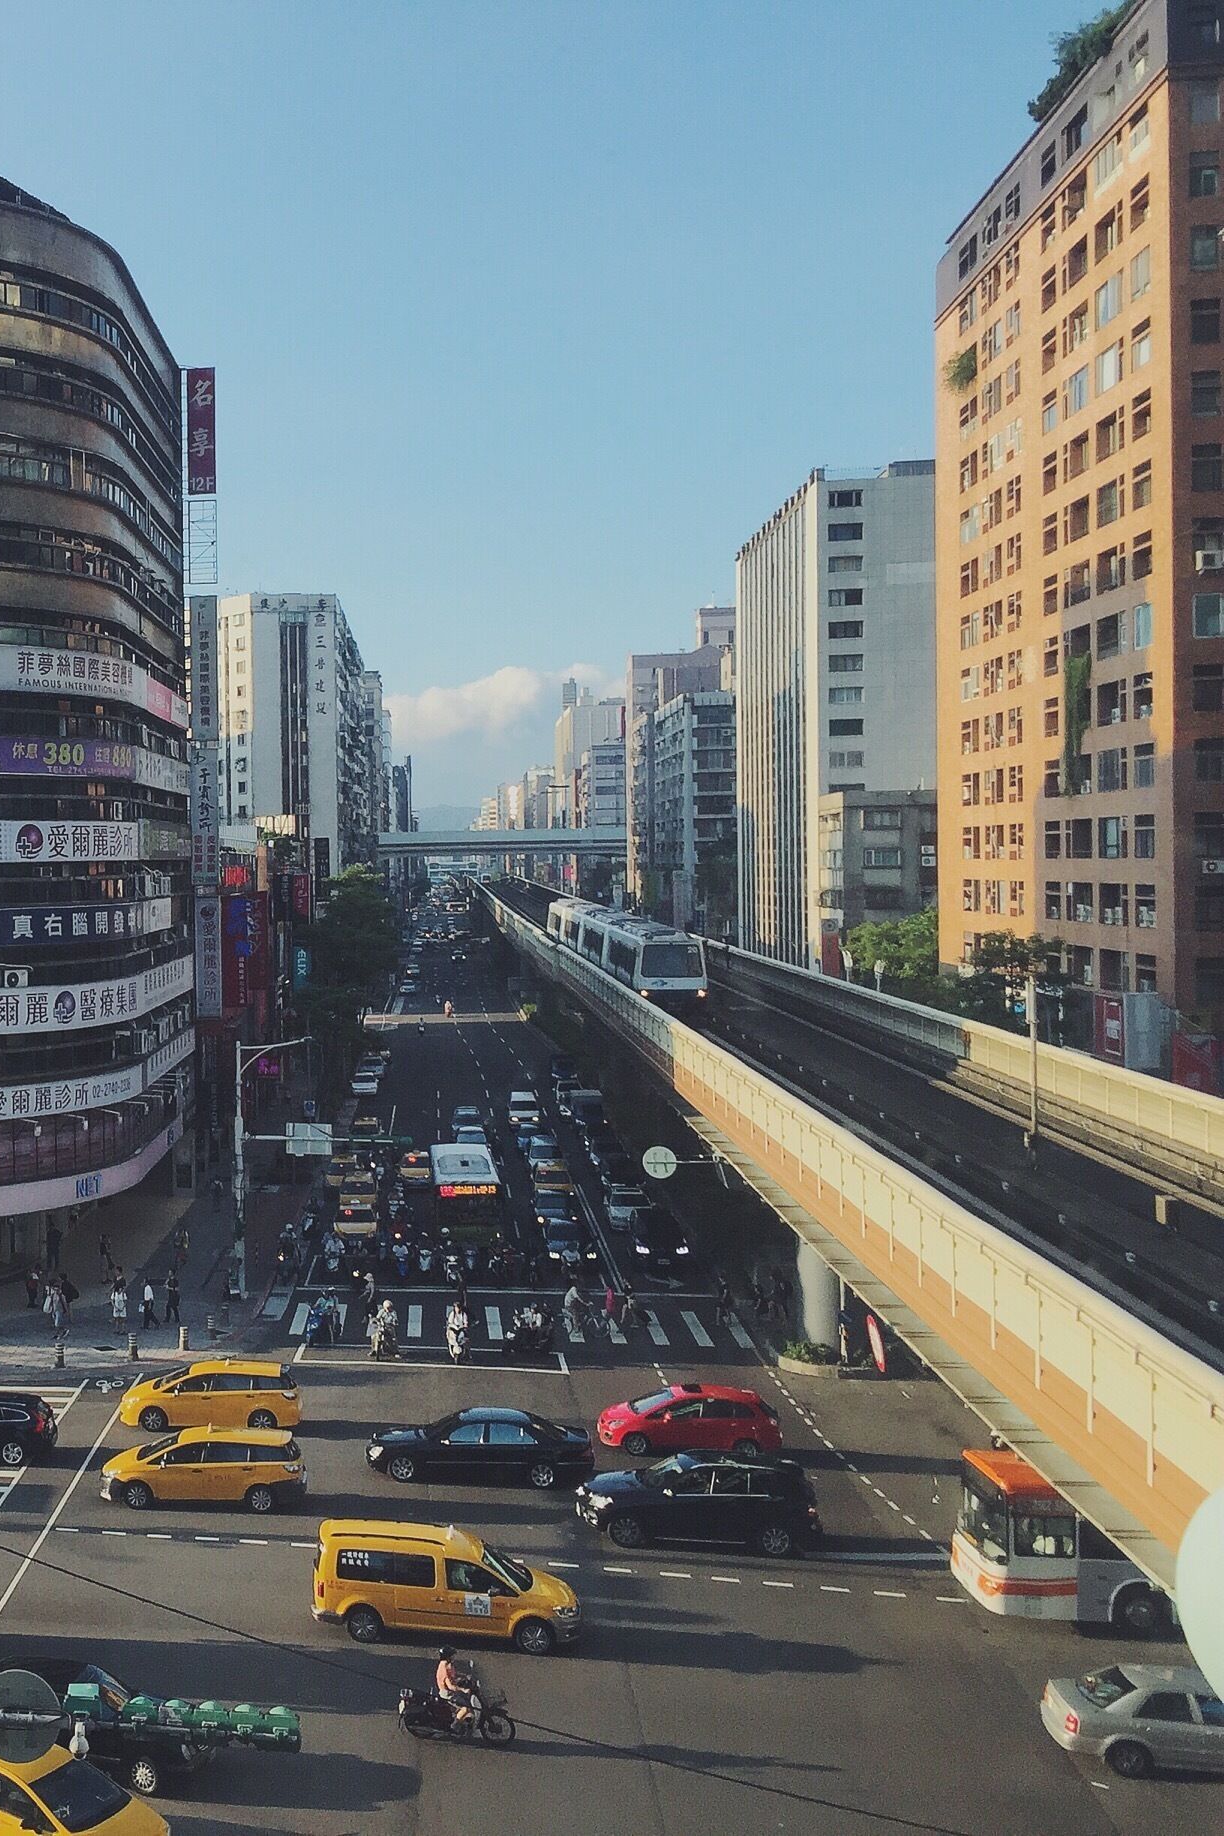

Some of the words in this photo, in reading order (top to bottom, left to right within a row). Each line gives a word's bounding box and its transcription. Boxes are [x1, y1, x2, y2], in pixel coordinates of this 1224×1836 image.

[189, 476, 215, 491] 12F
[18, 677, 63, 690] FAMOUS
[42, 742, 86, 767] 380
[112, 745, 132, 768] 880
[47, 824, 136, 858] 愛爾麗診所
[76, 1173, 103, 1199] NET
